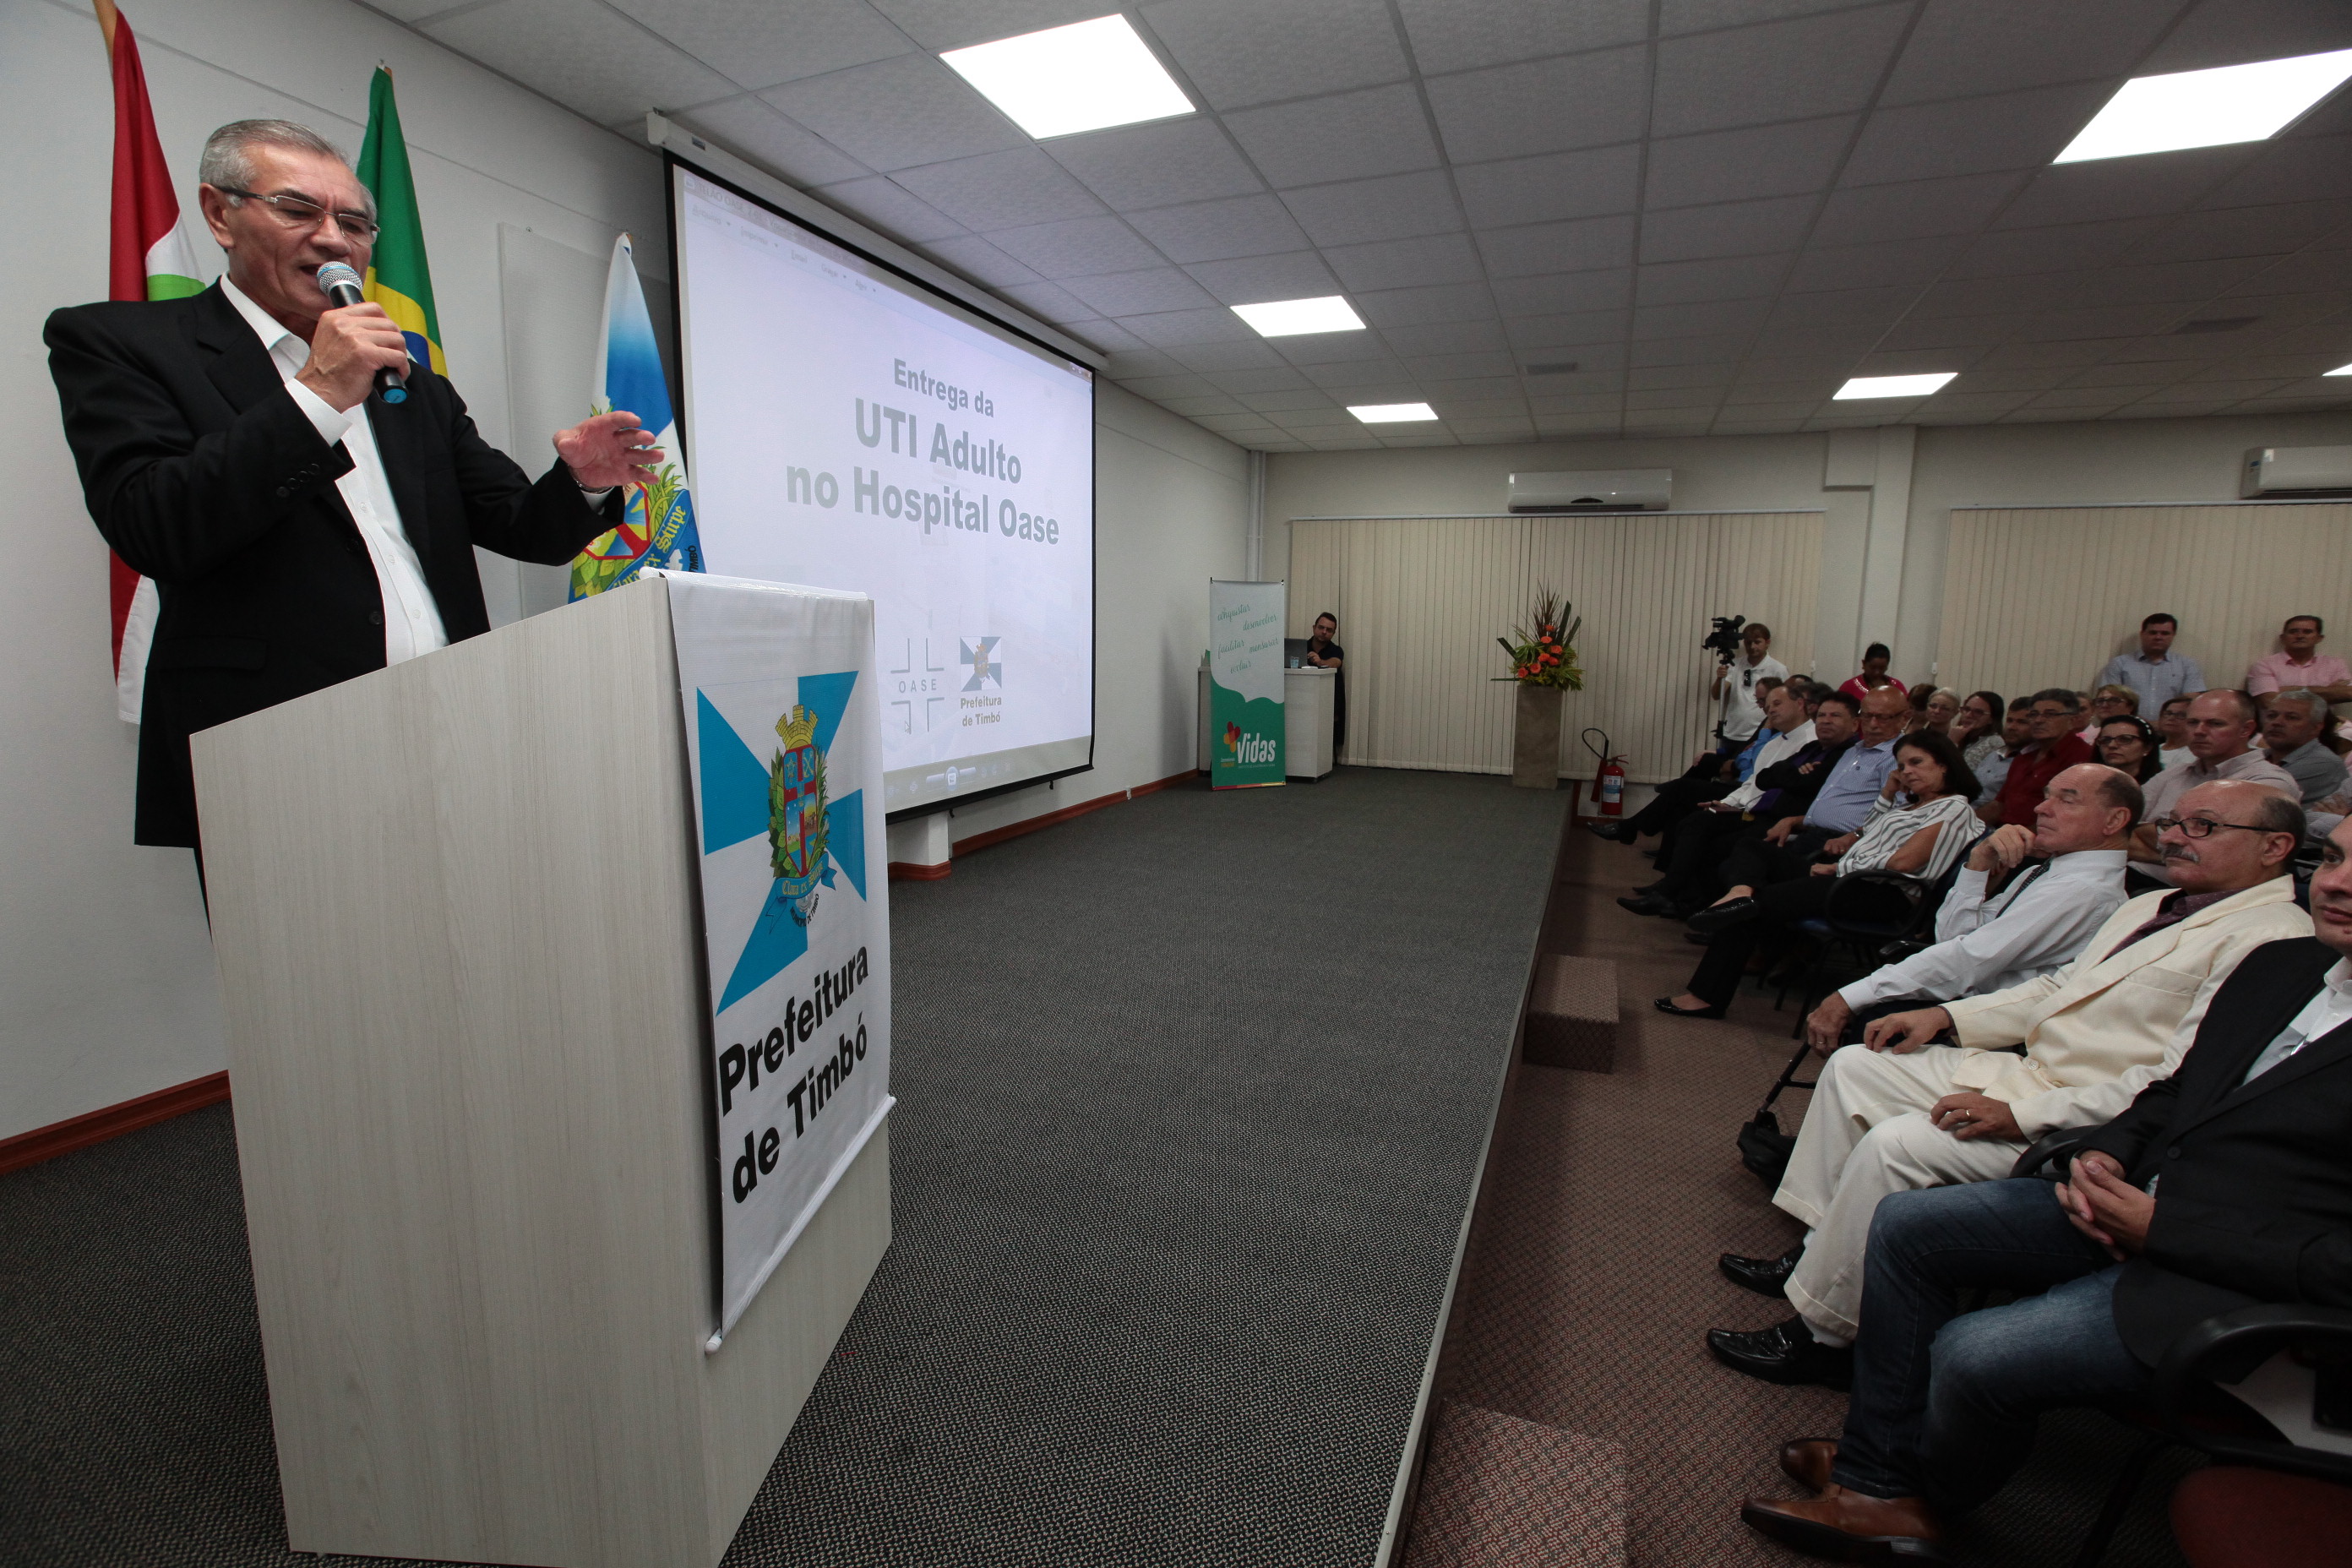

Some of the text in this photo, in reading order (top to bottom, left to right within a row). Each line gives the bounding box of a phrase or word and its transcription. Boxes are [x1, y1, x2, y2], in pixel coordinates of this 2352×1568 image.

[894, 357, 994, 418] Entrega da
[855, 397, 1021, 484] UTI Adulto
[787, 466, 1059, 546] no Hospital Oase
[898, 678, 937, 694] OASE
[960, 696, 1002, 710] Prefeitura
[961, 710, 1001, 727] de Timbó
[1237, 732, 1277, 764] Vidas
[719, 945, 868, 1118] Prefeitura
[732, 1010, 868, 1204] de Timbó
